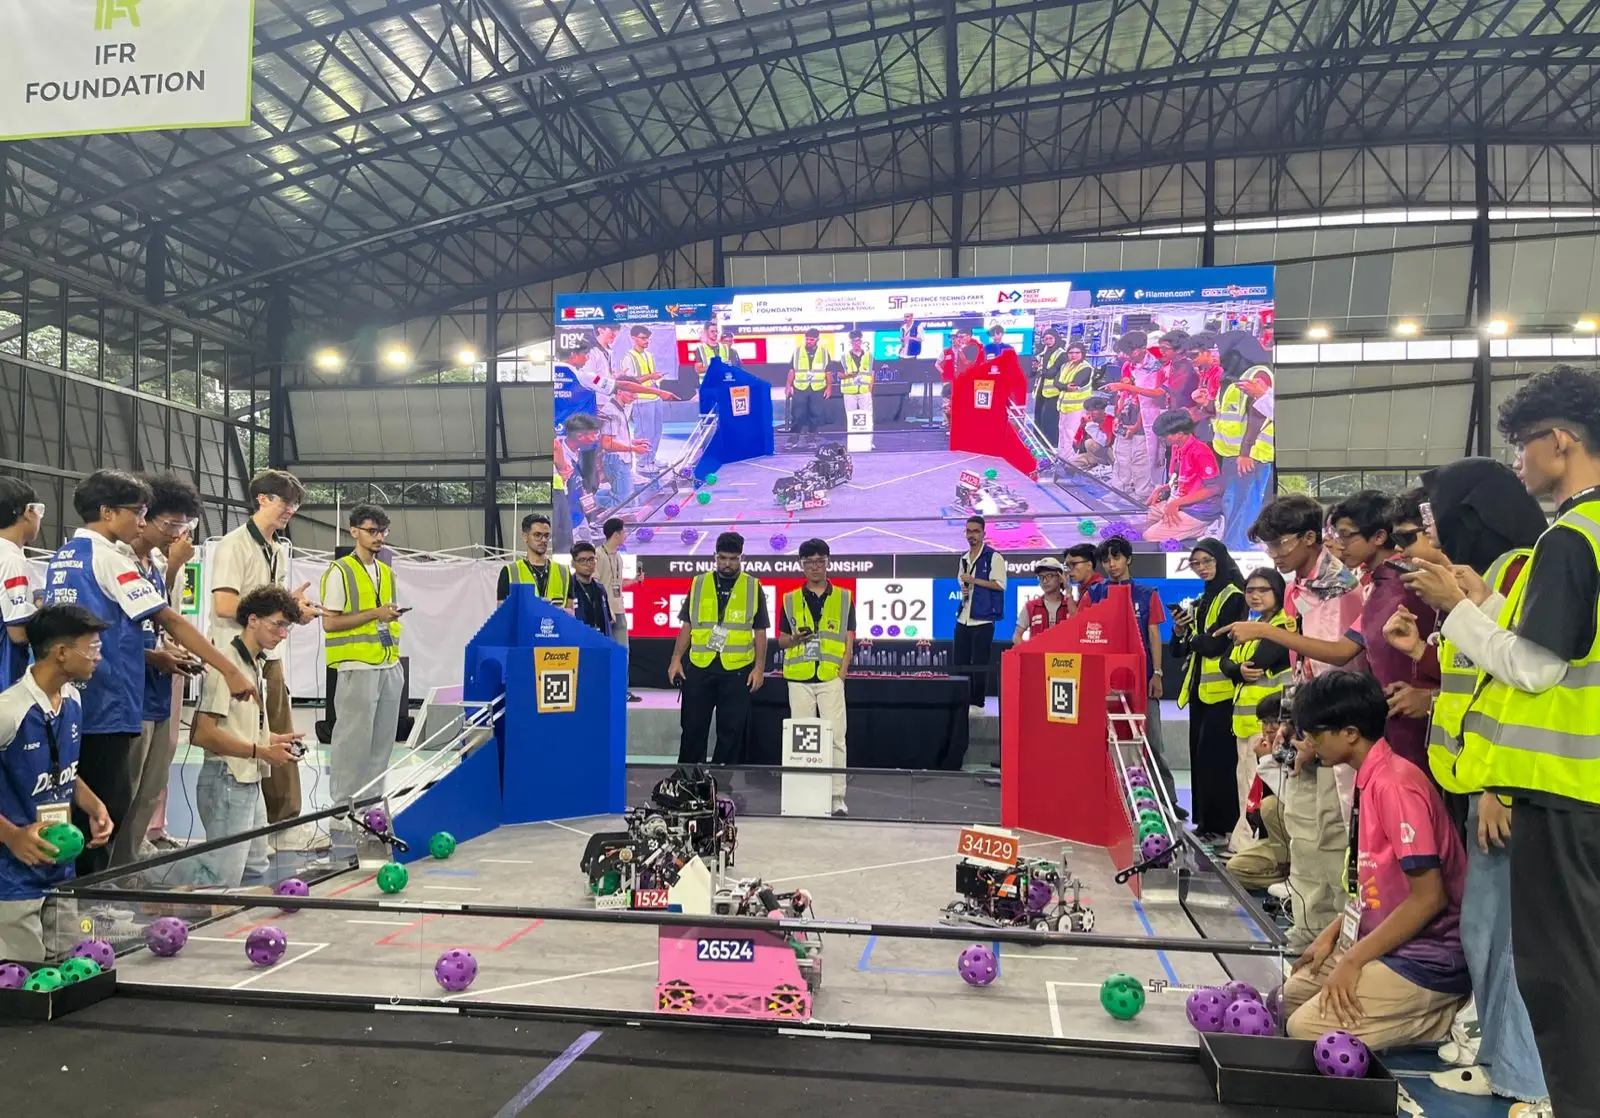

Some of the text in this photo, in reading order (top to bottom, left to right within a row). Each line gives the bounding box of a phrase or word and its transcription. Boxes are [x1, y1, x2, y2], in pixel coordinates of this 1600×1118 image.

[95, 42, 136, 66] IFR
[25, 69, 205, 104] FOUNDATION
[756, 306, 803, 314] FOUNDATION
[669, 561, 695, 572] FTC
[863, 599, 927, 621] 1:02
[962, 833, 1013, 860] 34129
[698, 940, 752, 960] 26524
